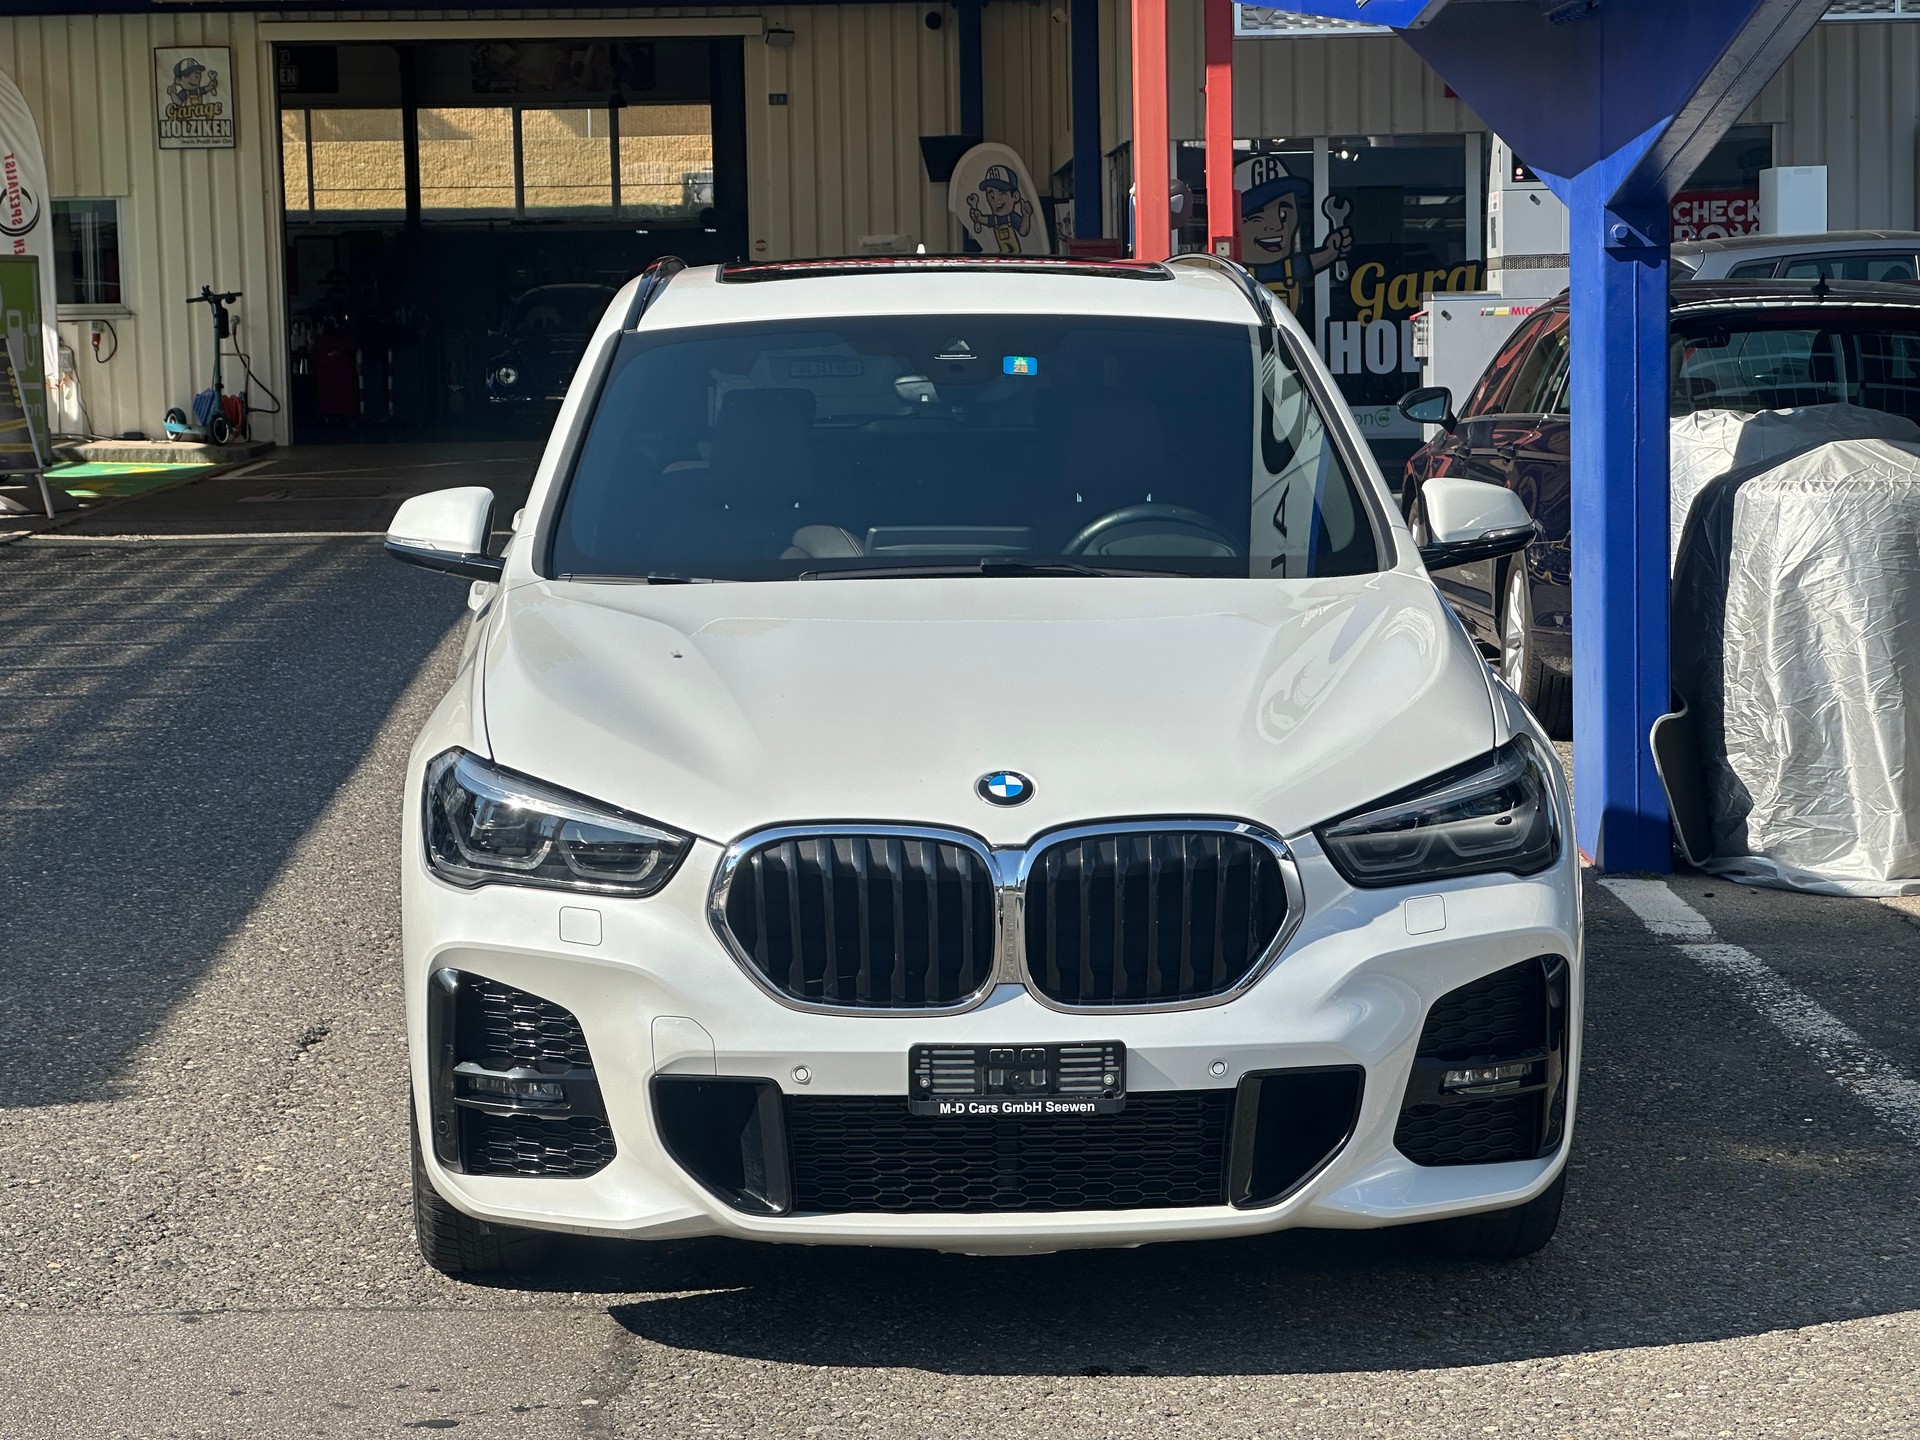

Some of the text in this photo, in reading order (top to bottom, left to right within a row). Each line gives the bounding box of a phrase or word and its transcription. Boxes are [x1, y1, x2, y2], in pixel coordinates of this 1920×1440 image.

[165, 101, 223, 121] Garage
[160, 119, 232, 138] HOLZIKEN
[1251, 157, 1279, 187] GB
[1672, 200, 1760, 224] CHECK
[1350, 262, 1487, 328] Gara
[1510, 306, 1539, 316] MIG
[939, 1101, 1095, 1114] M-D Cars GmbH Seewen
